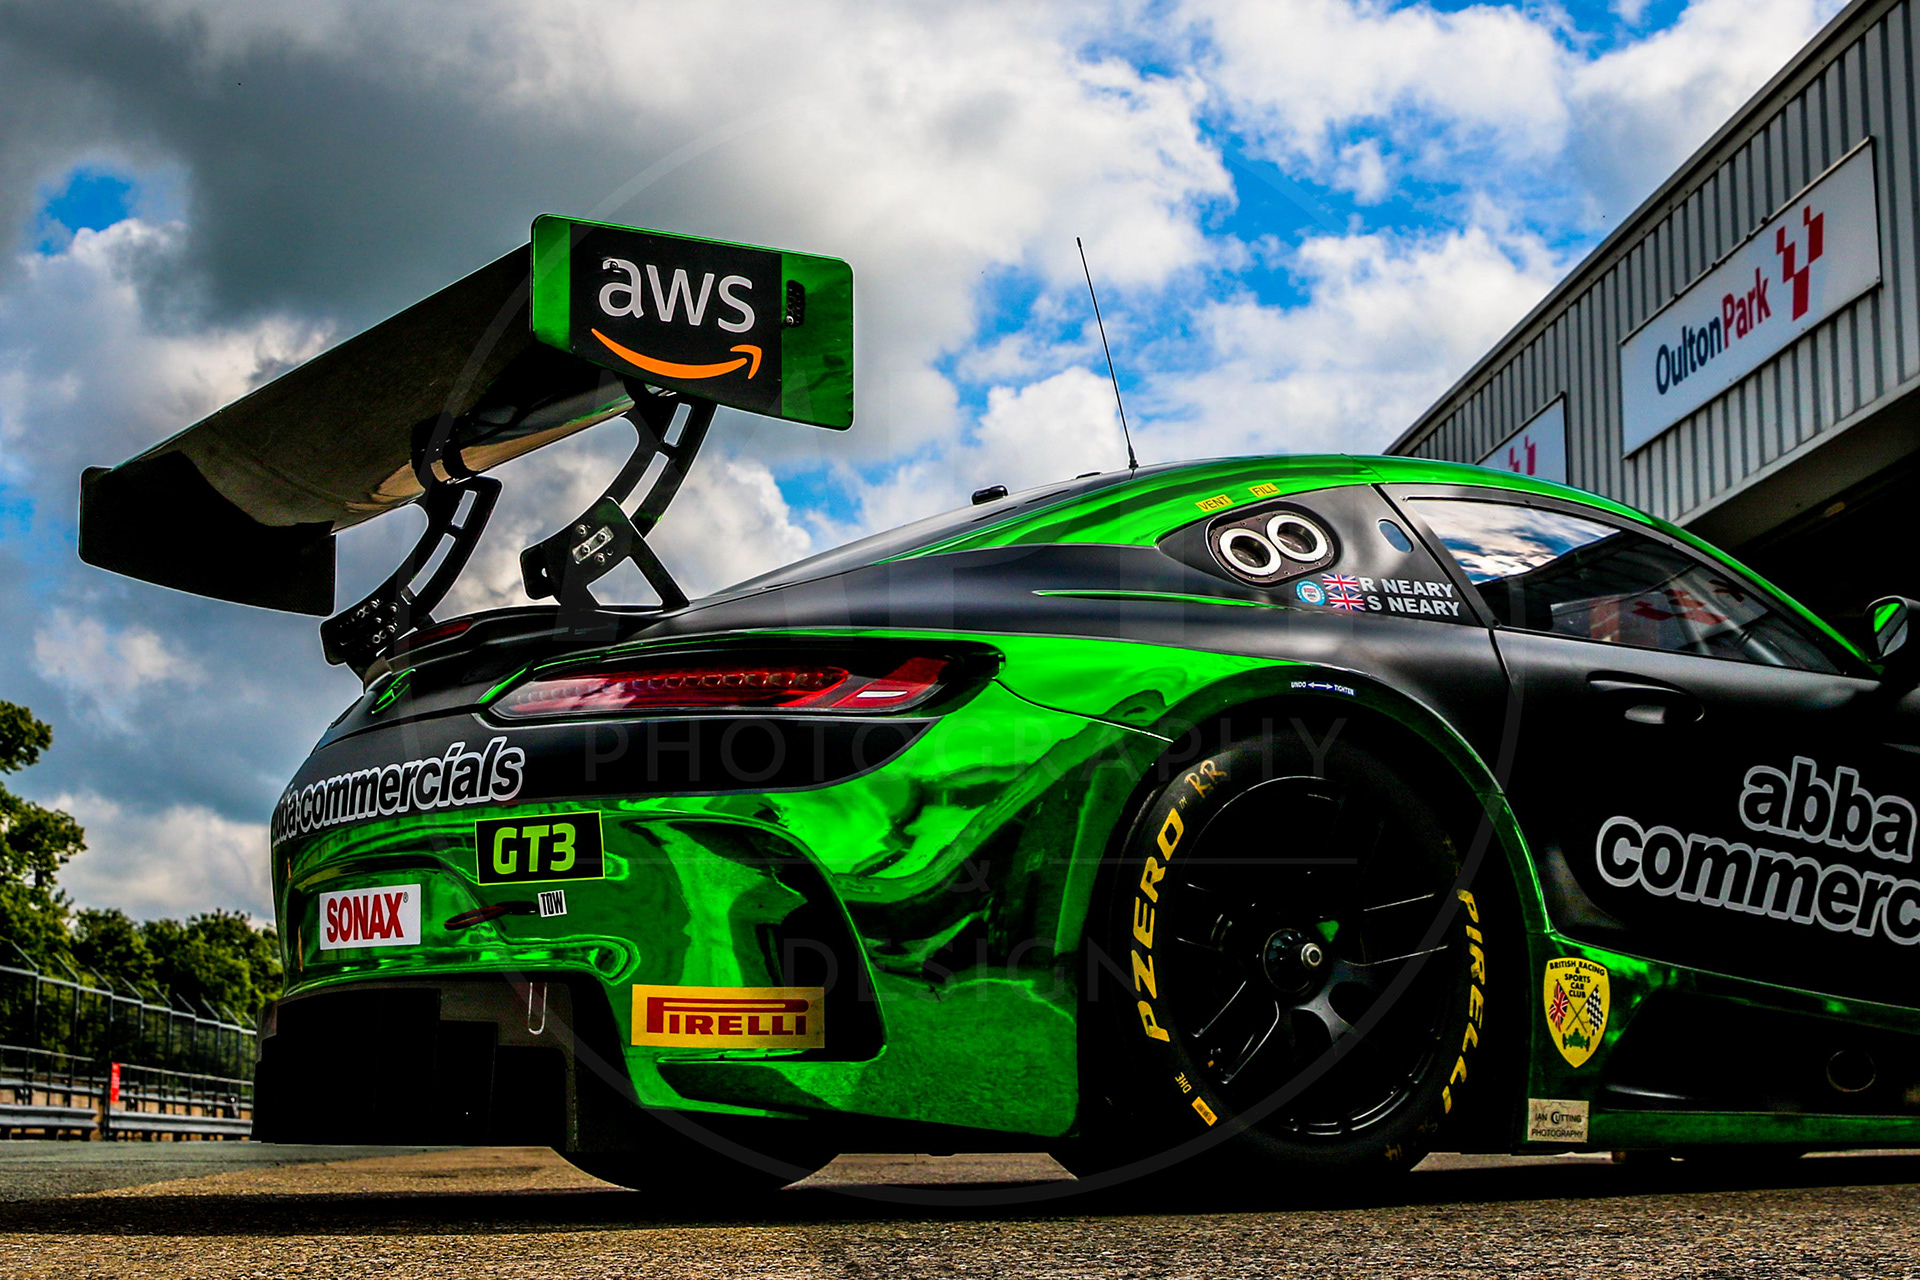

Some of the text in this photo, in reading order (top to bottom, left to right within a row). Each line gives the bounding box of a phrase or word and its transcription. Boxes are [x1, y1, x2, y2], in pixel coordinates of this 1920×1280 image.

[599, 257, 755, 333] aws
[1656, 267, 1771, 395] OultonPark
[1252, 484, 1278, 496] FILL
[1197, 495, 1229, 510] VENT
[1358, 577, 1453, 598] R NEARY
[1368, 596, 1459, 616] S NEARY
[1739, 755, 1916, 863] abba
[492, 821, 577, 876] GT3
[541, 891, 564, 916] TOW
[1549, 960, 1605, 976] BRITISH RACING
[1564, 973, 1591, 983] SPORTS
[1568, 990, 1587, 998] CLUB
[1570, 982, 1585, 990] CAR
[1442, 888, 1486, 1113] PIRELLI
[646, 997, 809, 1036] PIRELLI
[1535, 1111, 1582, 1124] IAN CUTTING
[1531, 1128, 1584, 1138] PHOTOGRAPHY
